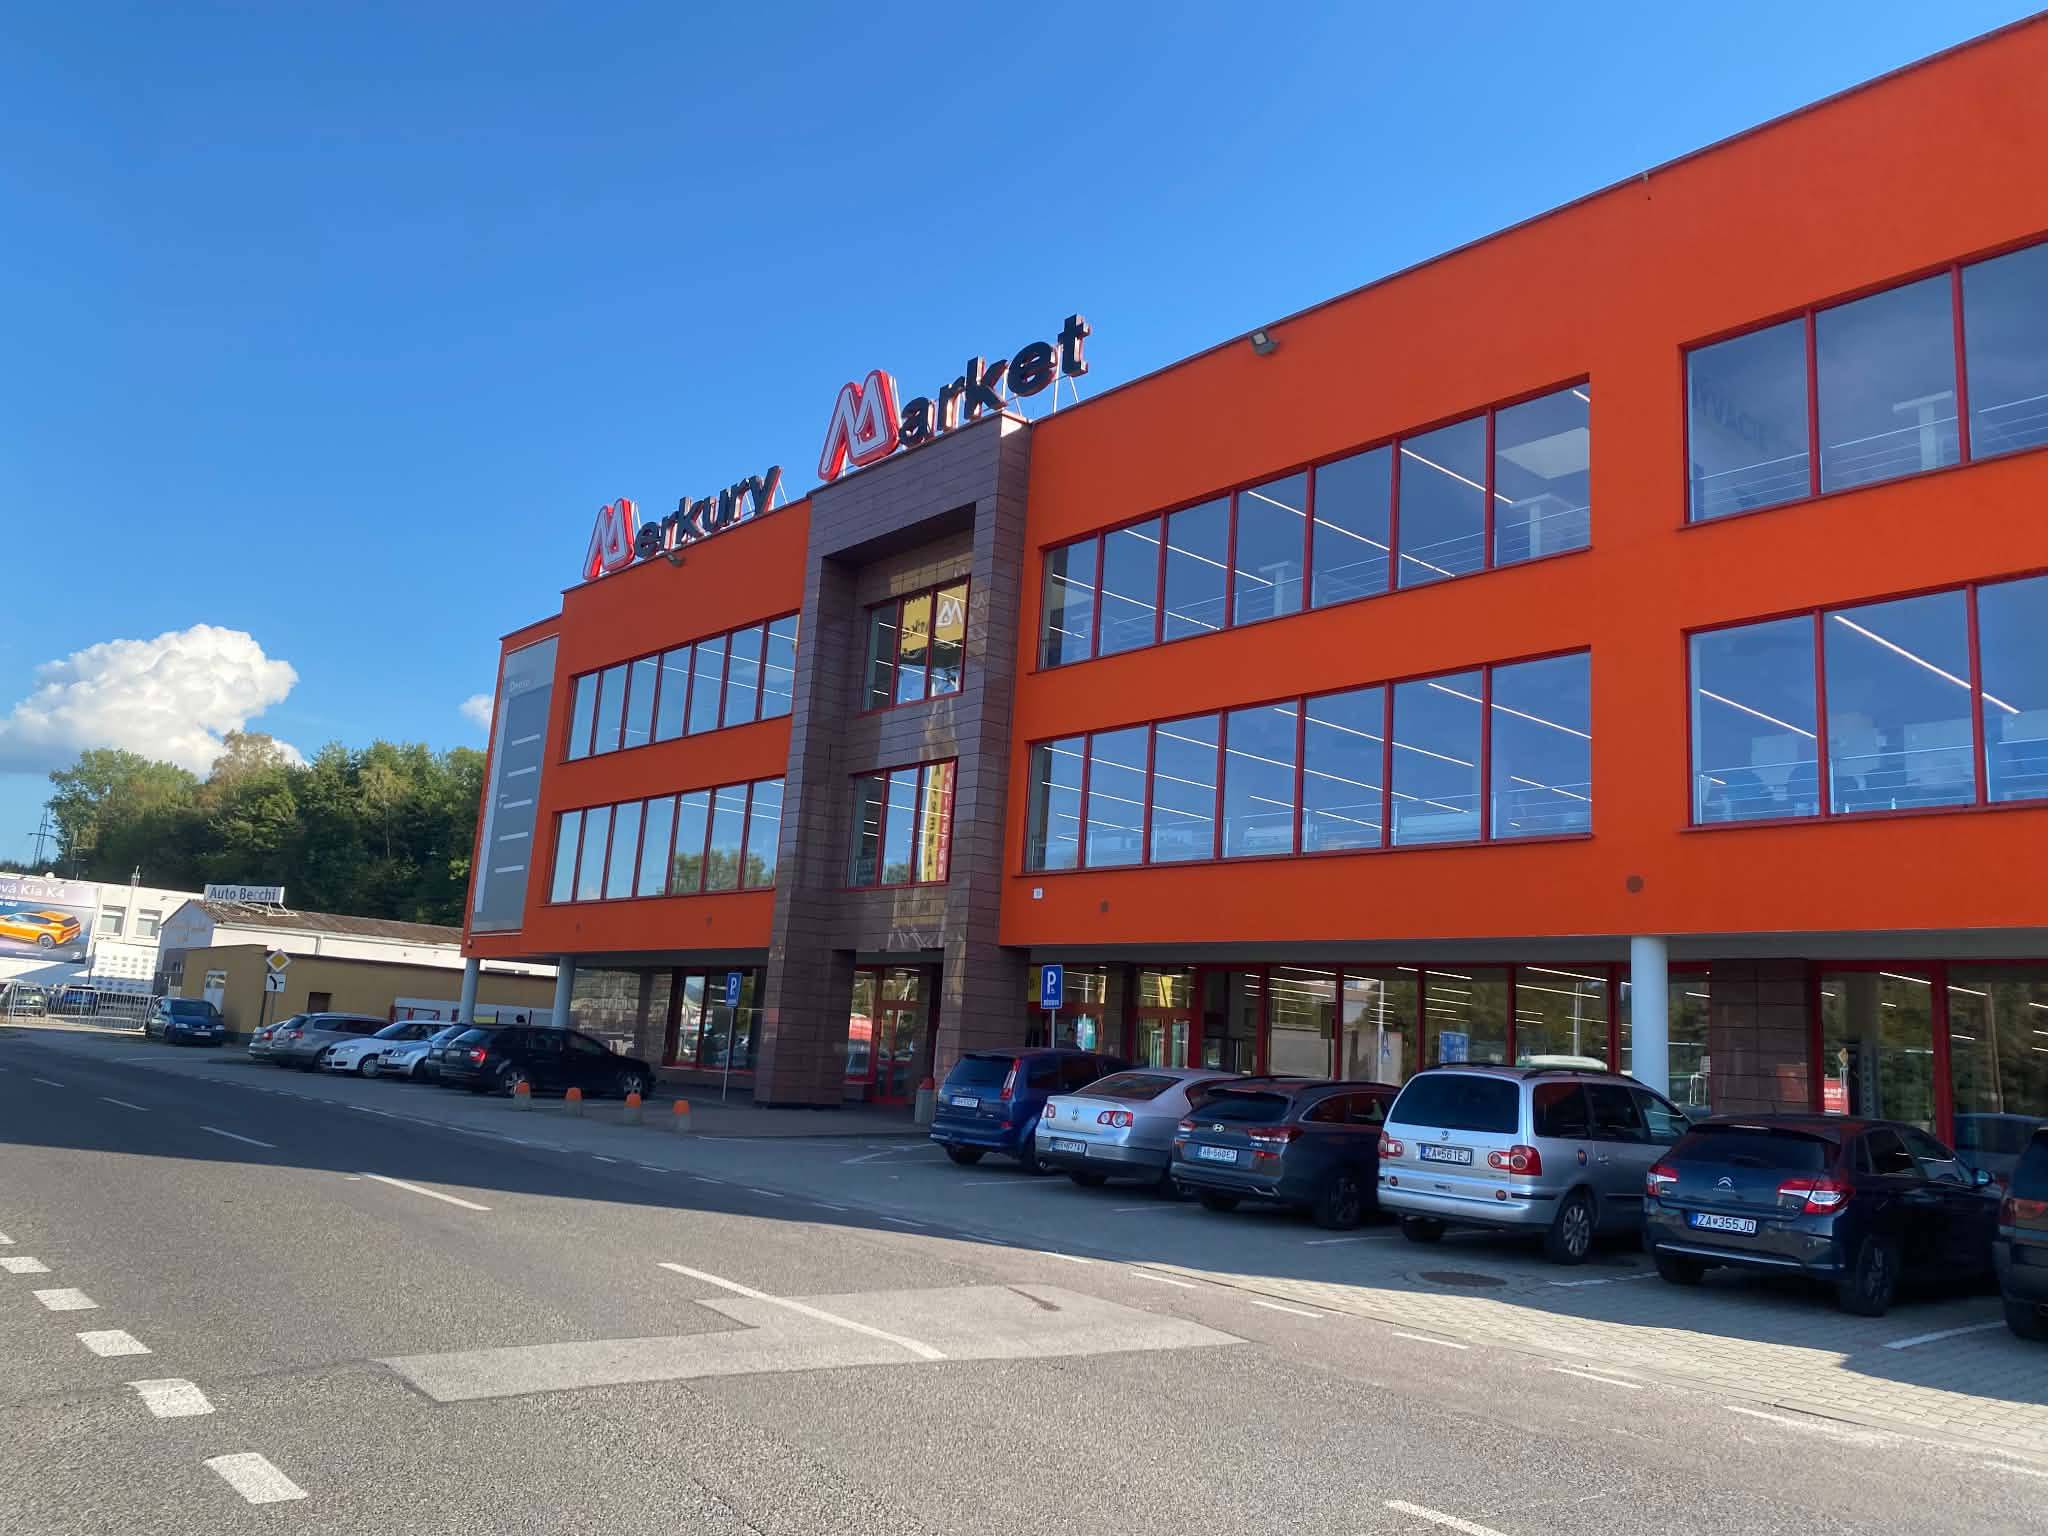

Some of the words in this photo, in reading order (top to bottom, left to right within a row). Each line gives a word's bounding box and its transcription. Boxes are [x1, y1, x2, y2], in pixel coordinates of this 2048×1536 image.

[583, 465, 782, 580] Merkury
[818, 314, 1090, 481] Market
[21, 885, 42, 896] Kia
[209, 887, 236, 899] Auto
[1047, 970, 1057, 995] P
